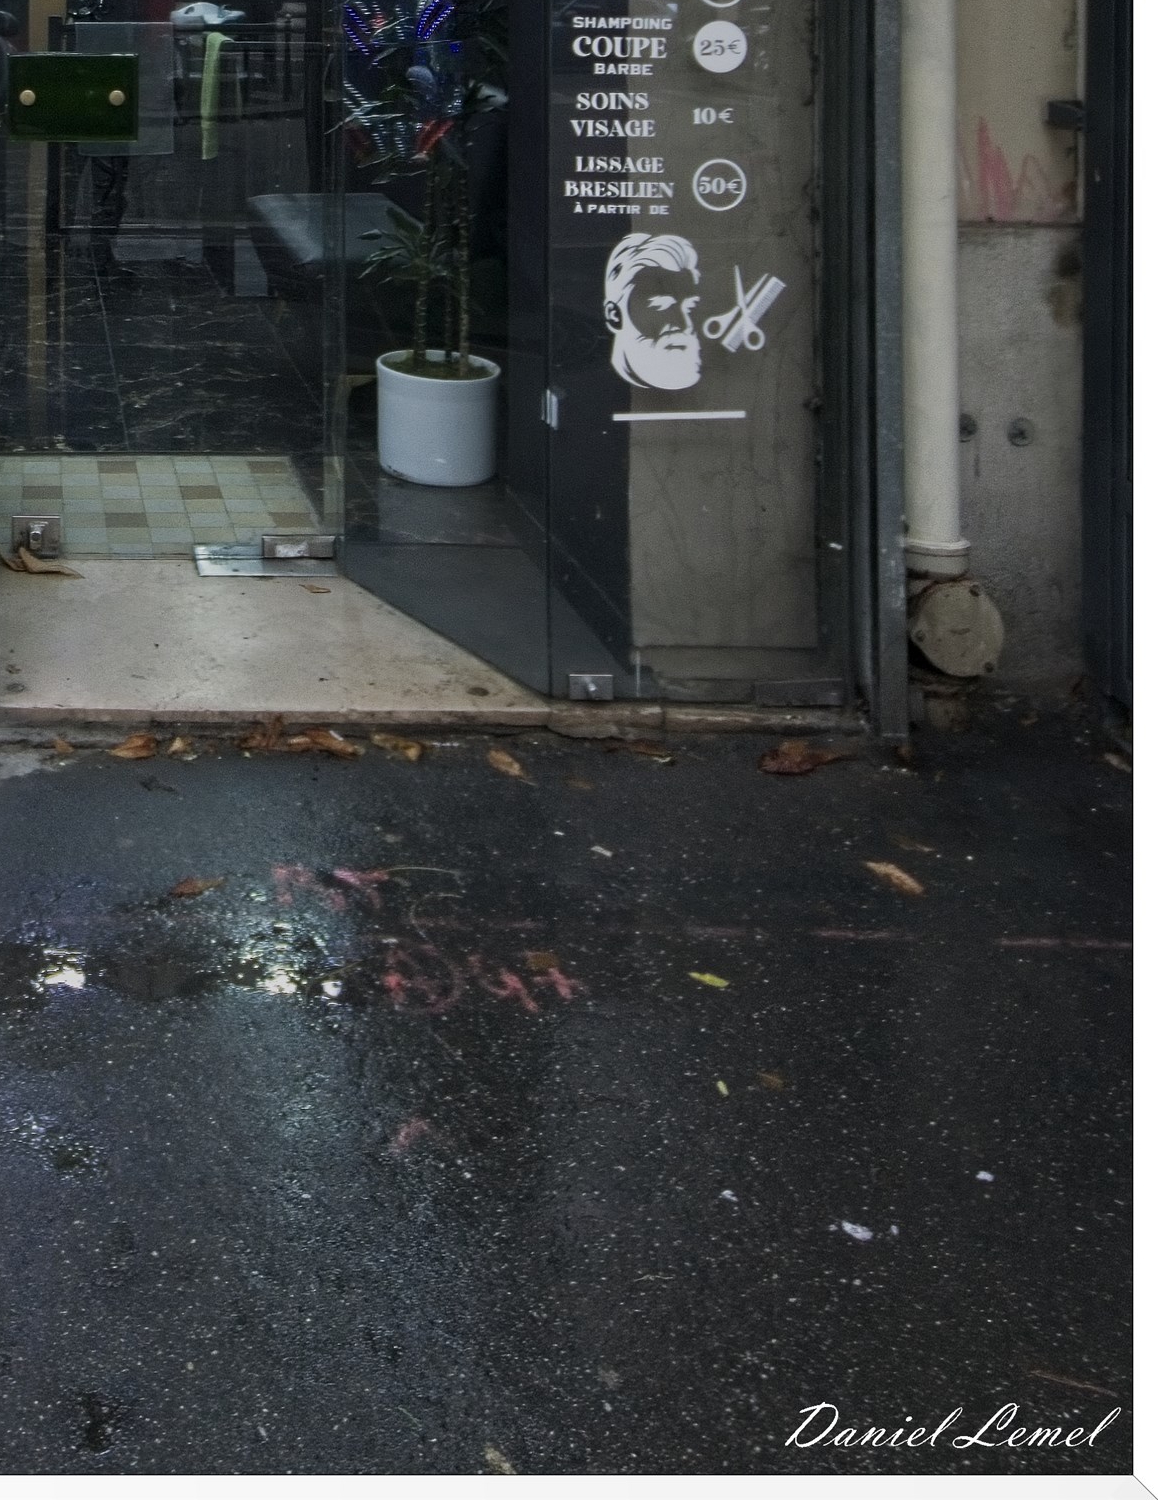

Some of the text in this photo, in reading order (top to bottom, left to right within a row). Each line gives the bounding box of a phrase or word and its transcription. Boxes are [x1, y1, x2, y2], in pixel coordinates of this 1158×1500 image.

[572, 16, 673, 30] SHAMPOING
[572, 36, 742, 58] COUPE 25€
[593, 63, 653, 75] BARBE
[576, 92, 649, 110] SOINS
[692, 107, 734, 125] 10€
[570, 119, 656, 137] VISAGE
[575, 156, 664, 173] LISSAGE
[564, 177, 742, 198] BRESILIEN 50€
[573, 201, 670, 215] À PARTIR DE
